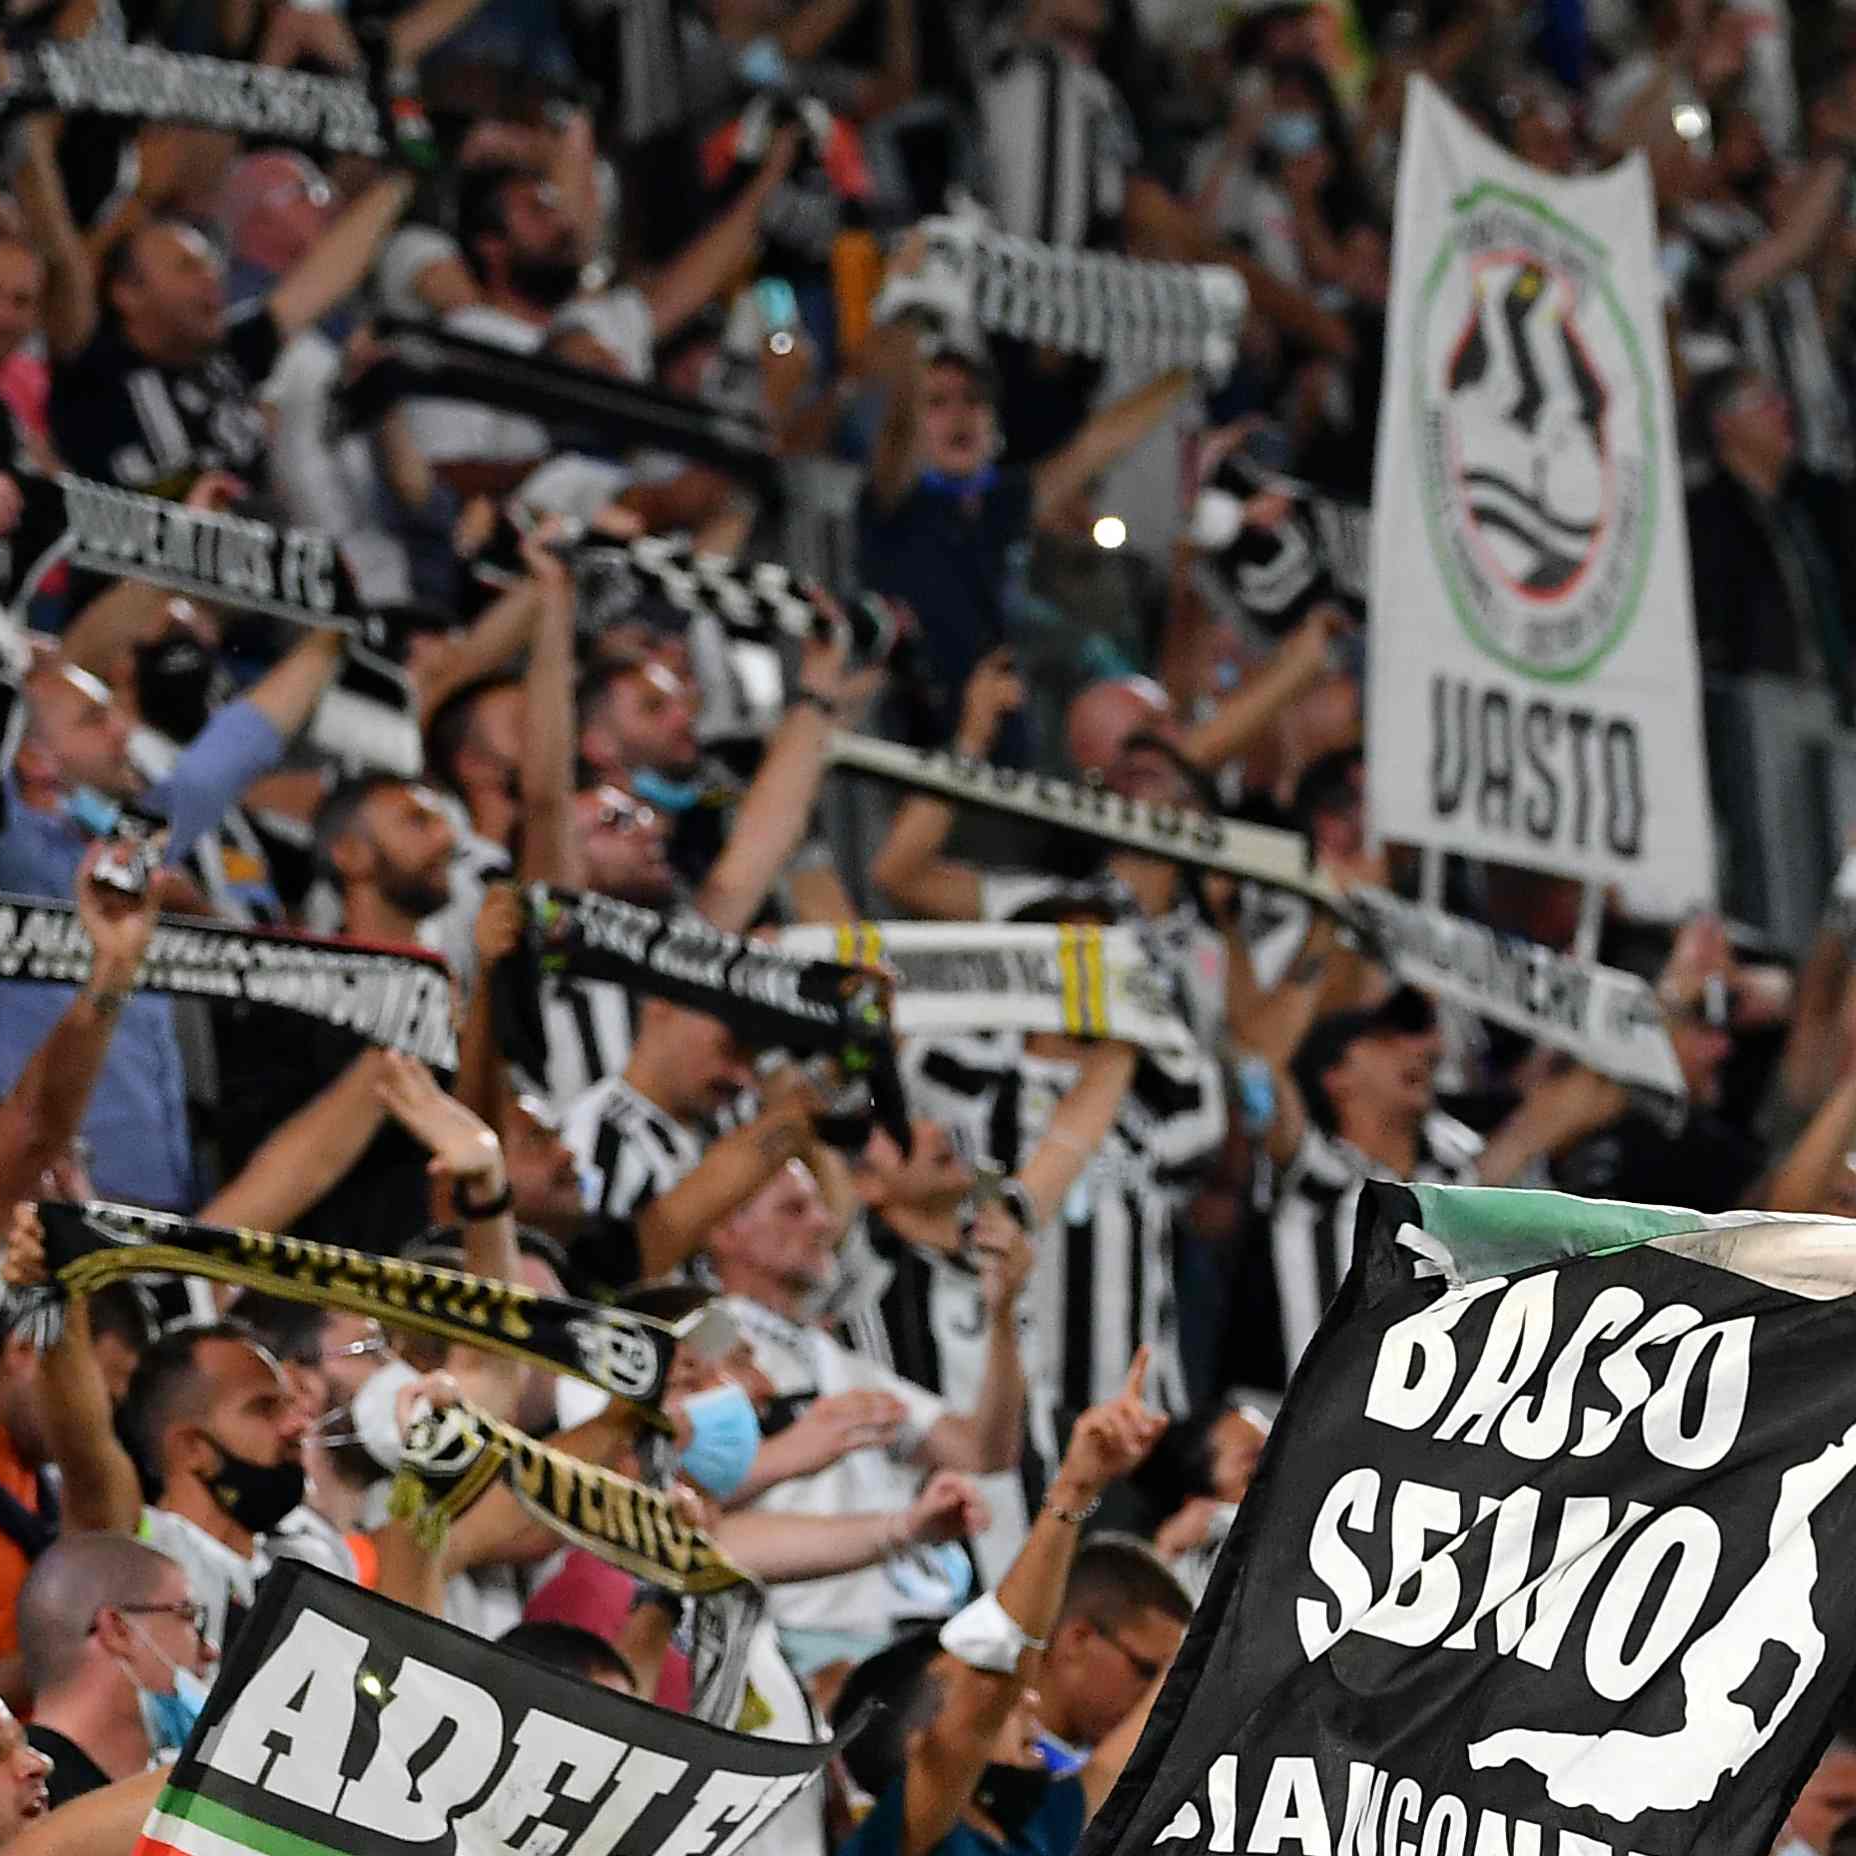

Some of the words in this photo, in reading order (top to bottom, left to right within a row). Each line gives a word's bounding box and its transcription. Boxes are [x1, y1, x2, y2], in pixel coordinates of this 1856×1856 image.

[1430, 672, 1643, 862] VASTO
[1362, 1266, 1756, 1472] BASSO
[1294, 1466, 1723, 1703] SEBINO
